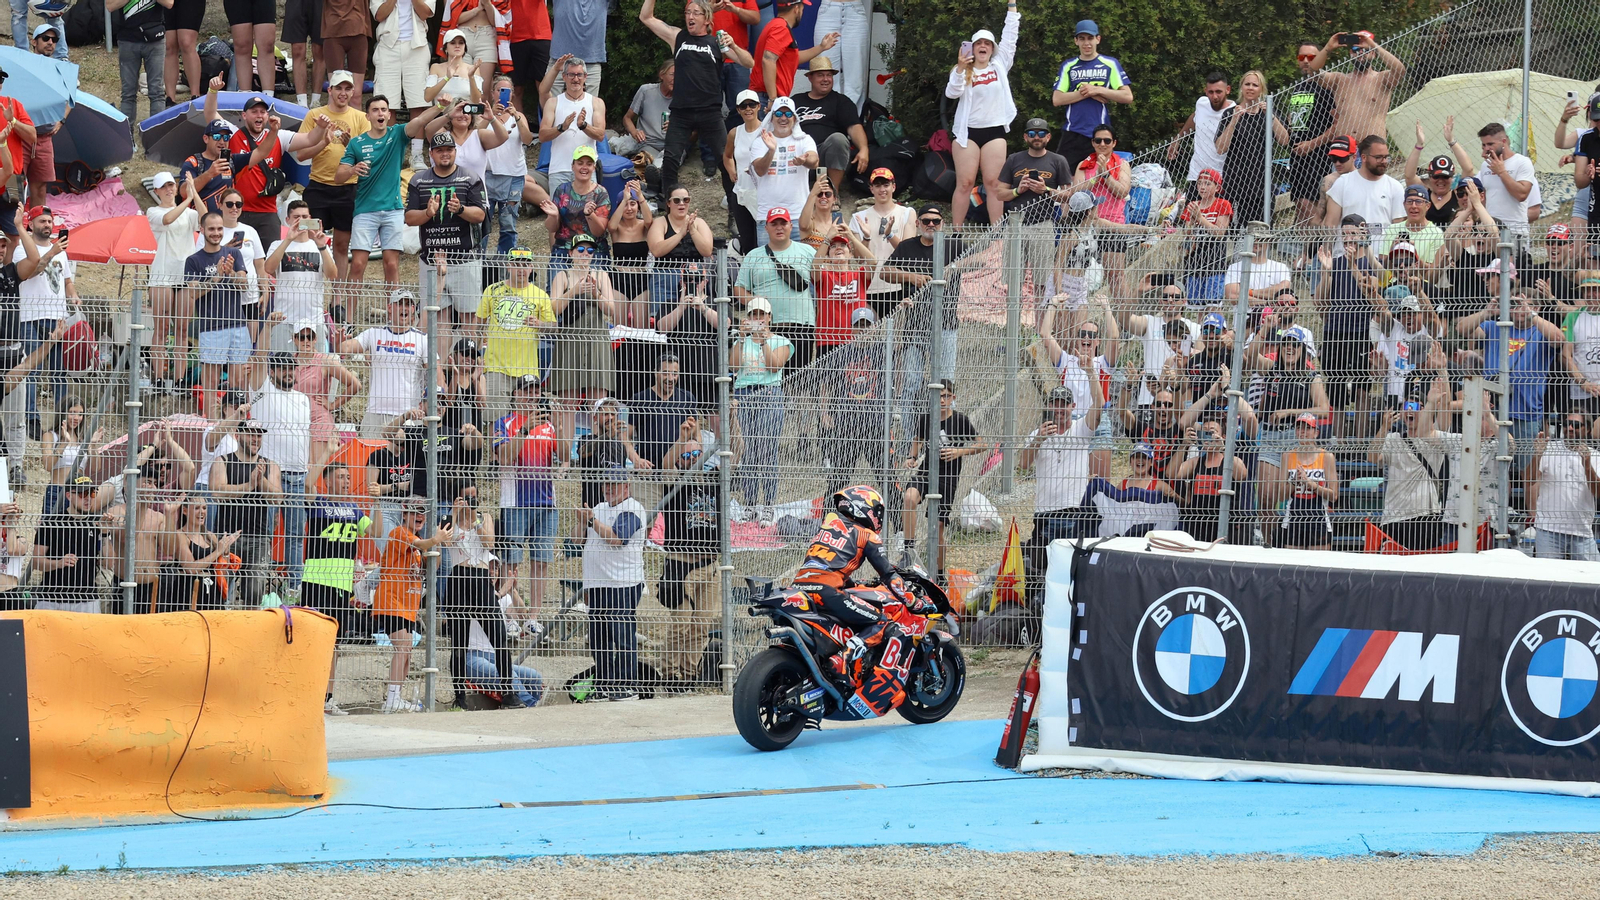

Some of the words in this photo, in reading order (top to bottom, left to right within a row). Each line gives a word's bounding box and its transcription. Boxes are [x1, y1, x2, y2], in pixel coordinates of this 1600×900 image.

[1077, 69, 1108, 78] YAMAHA
[425, 226, 461, 234] MONSTER
[432, 236, 462, 246] YAMAHA
[376, 339, 416, 356] HRC
[320, 522, 358, 543] 46
[821, 530, 848, 551] Bull
[806, 544, 837, 562] KTM
[1151, 594, 1238, 632] BMW
[1521, 617, 1600, 656] BMW
[1360, 631, 1461, 705] M
[857, 668, 903, 716] KTM
